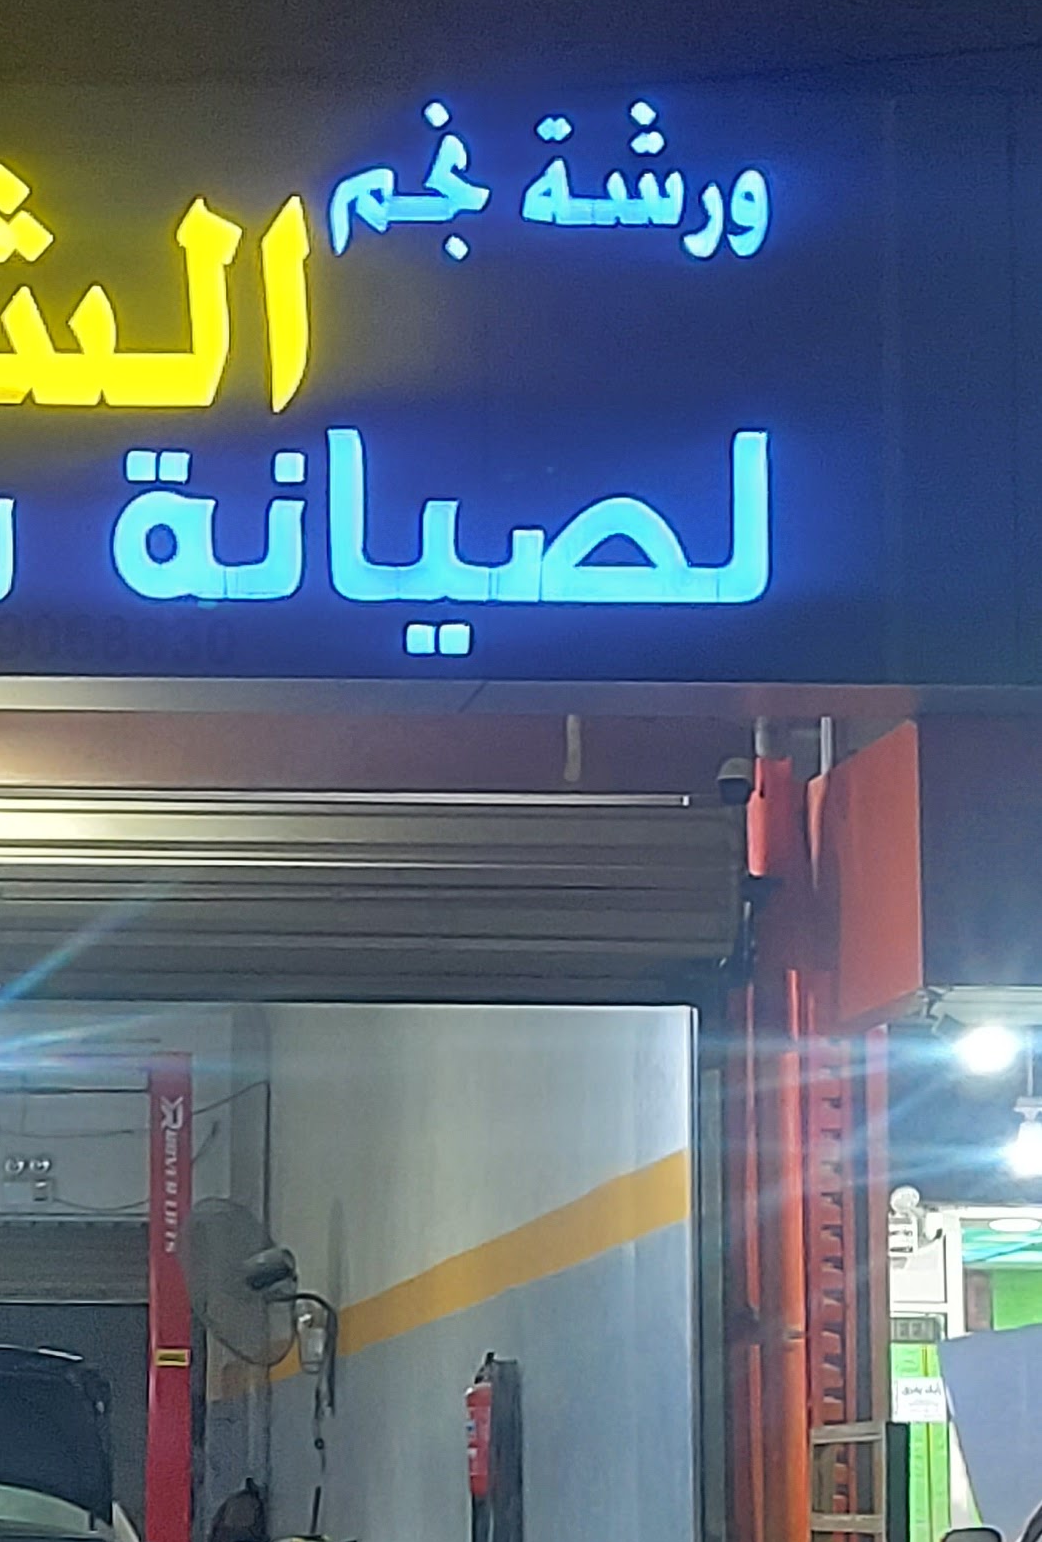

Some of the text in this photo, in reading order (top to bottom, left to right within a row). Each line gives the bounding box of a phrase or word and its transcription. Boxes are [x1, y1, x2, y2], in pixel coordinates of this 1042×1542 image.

[329, 100, 770, 262] ورشة نجم
[111, 426, 771, 656] لصيانة
